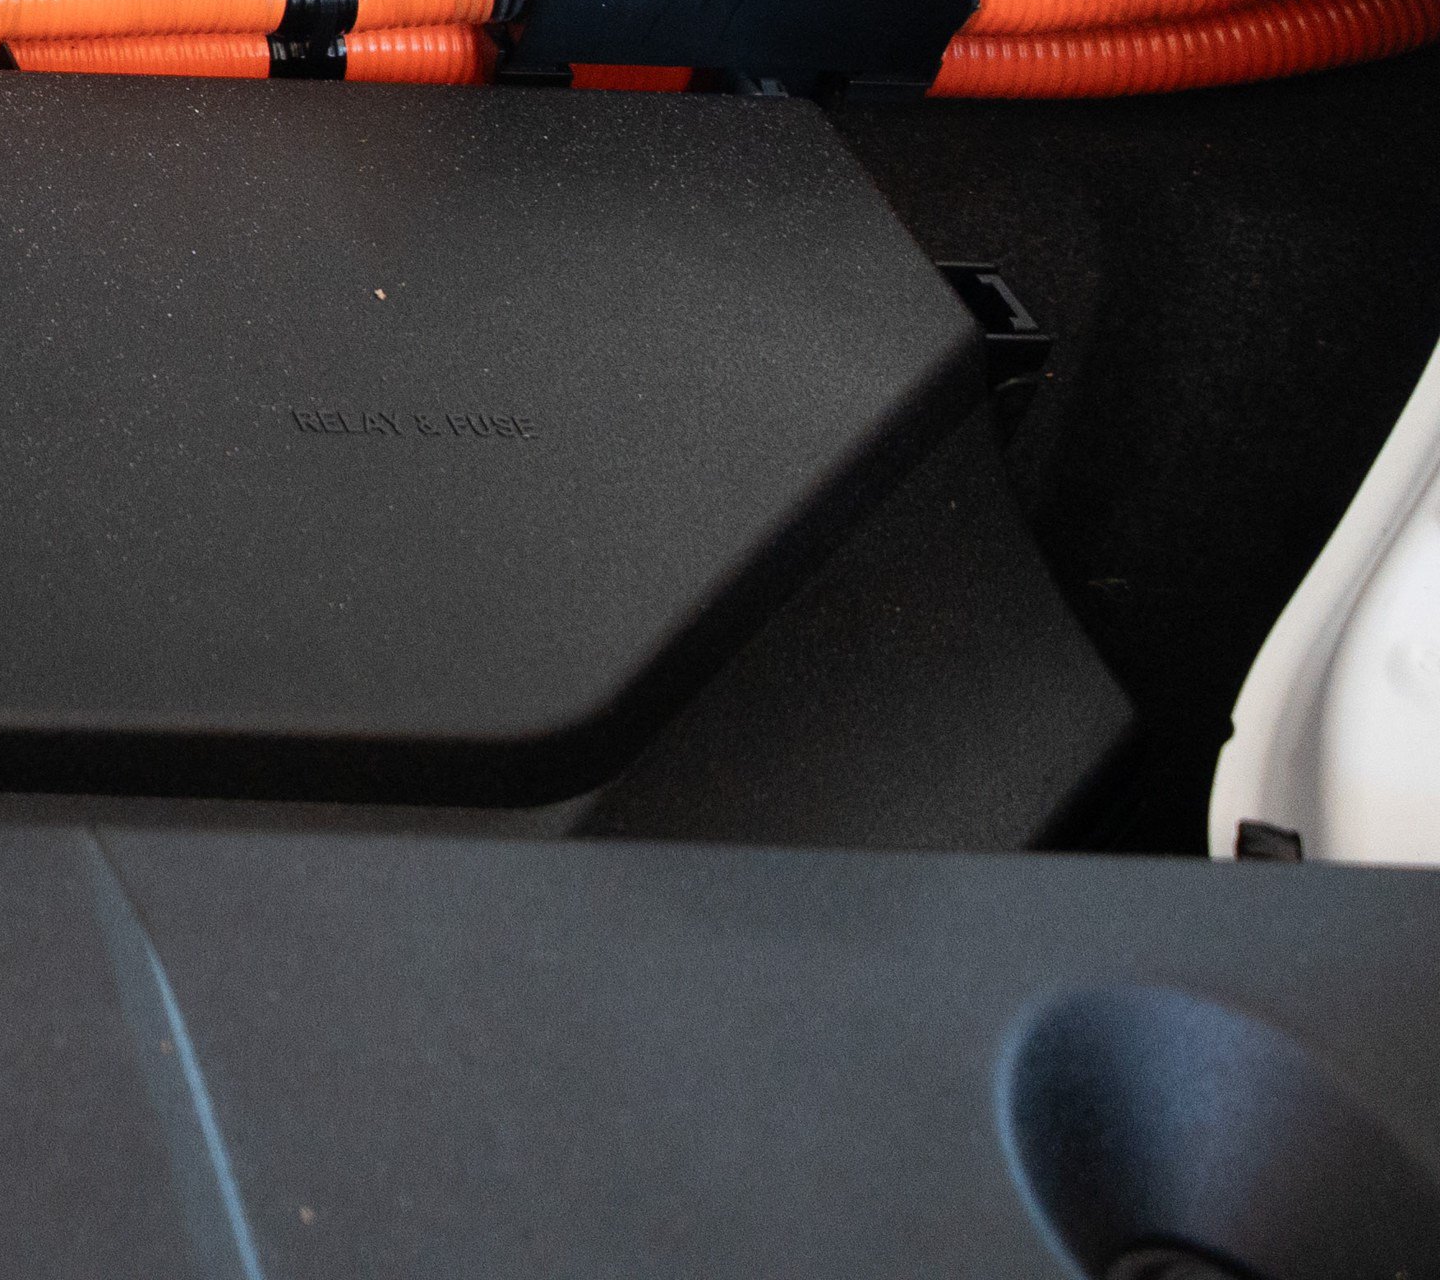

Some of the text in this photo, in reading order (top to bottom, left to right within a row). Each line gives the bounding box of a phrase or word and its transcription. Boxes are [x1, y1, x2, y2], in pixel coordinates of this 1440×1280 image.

[290, 408, 539, 440] RELAY & FUSE
